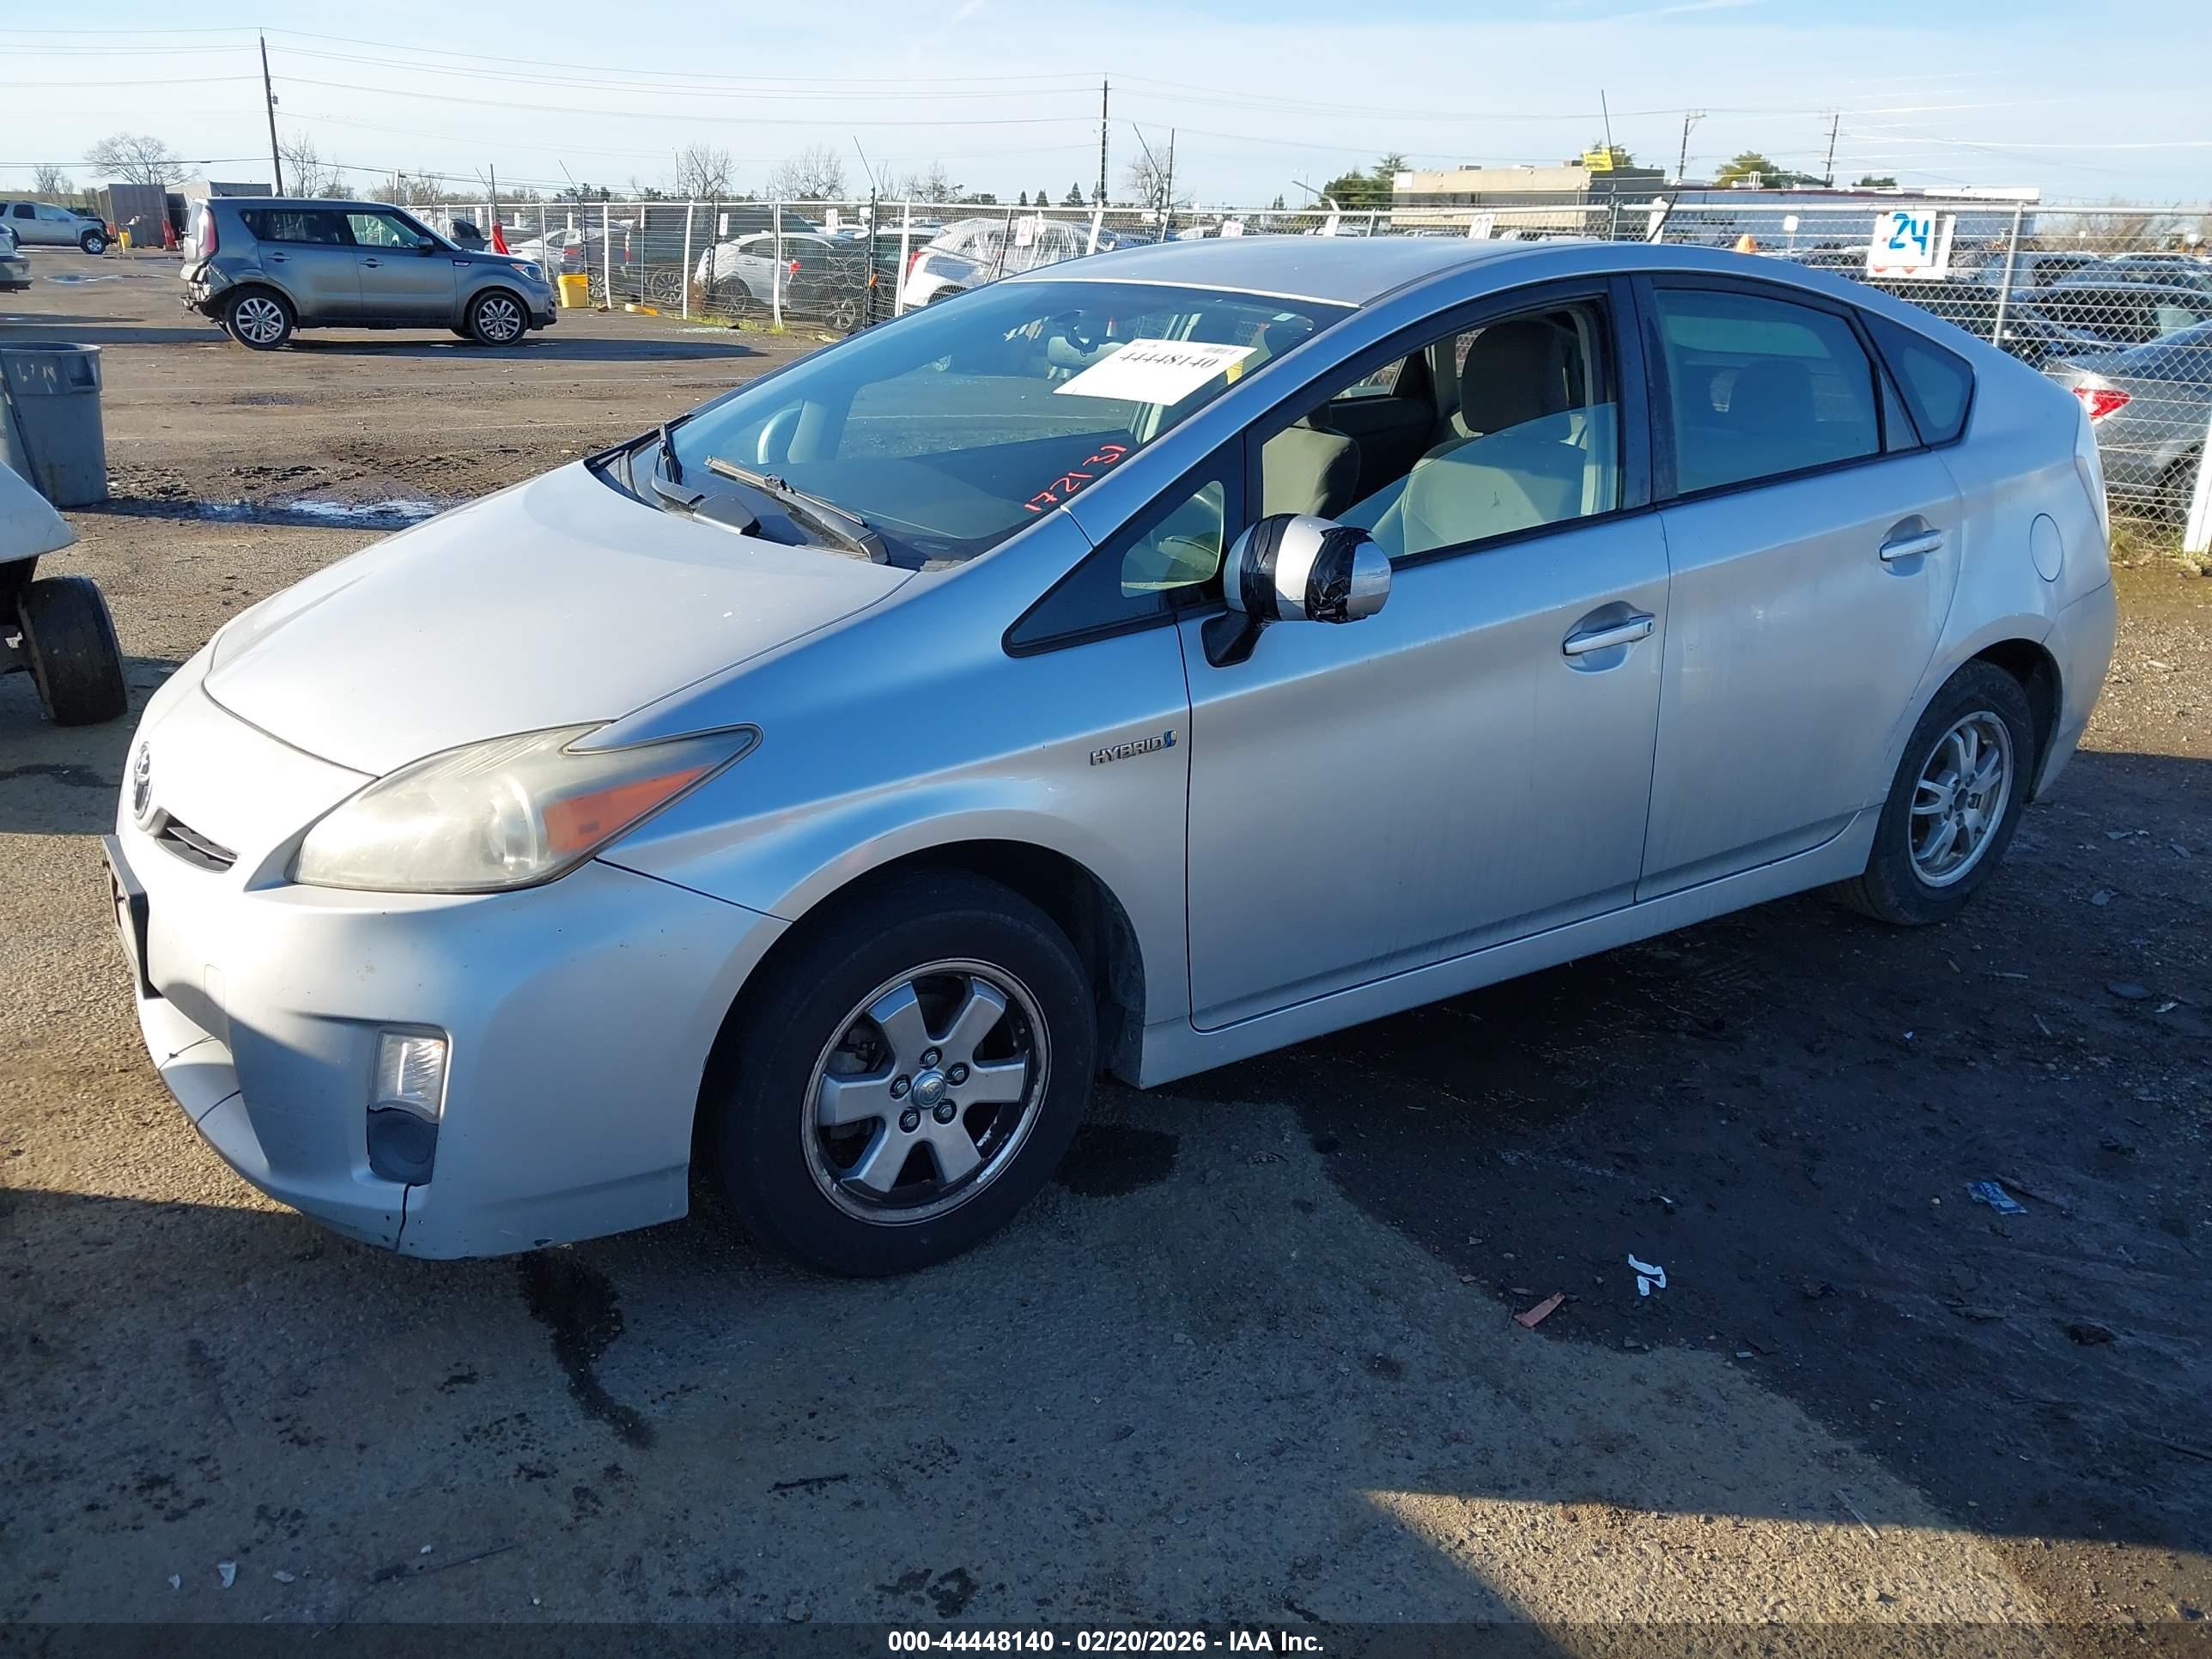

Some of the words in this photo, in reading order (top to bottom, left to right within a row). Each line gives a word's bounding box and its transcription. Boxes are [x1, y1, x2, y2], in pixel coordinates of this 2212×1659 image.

[1888, 212, 1929, 256] 24
[1120, 352, 1219, 368] 44448140
[1091, 736, 1162, 765] HYBRID
